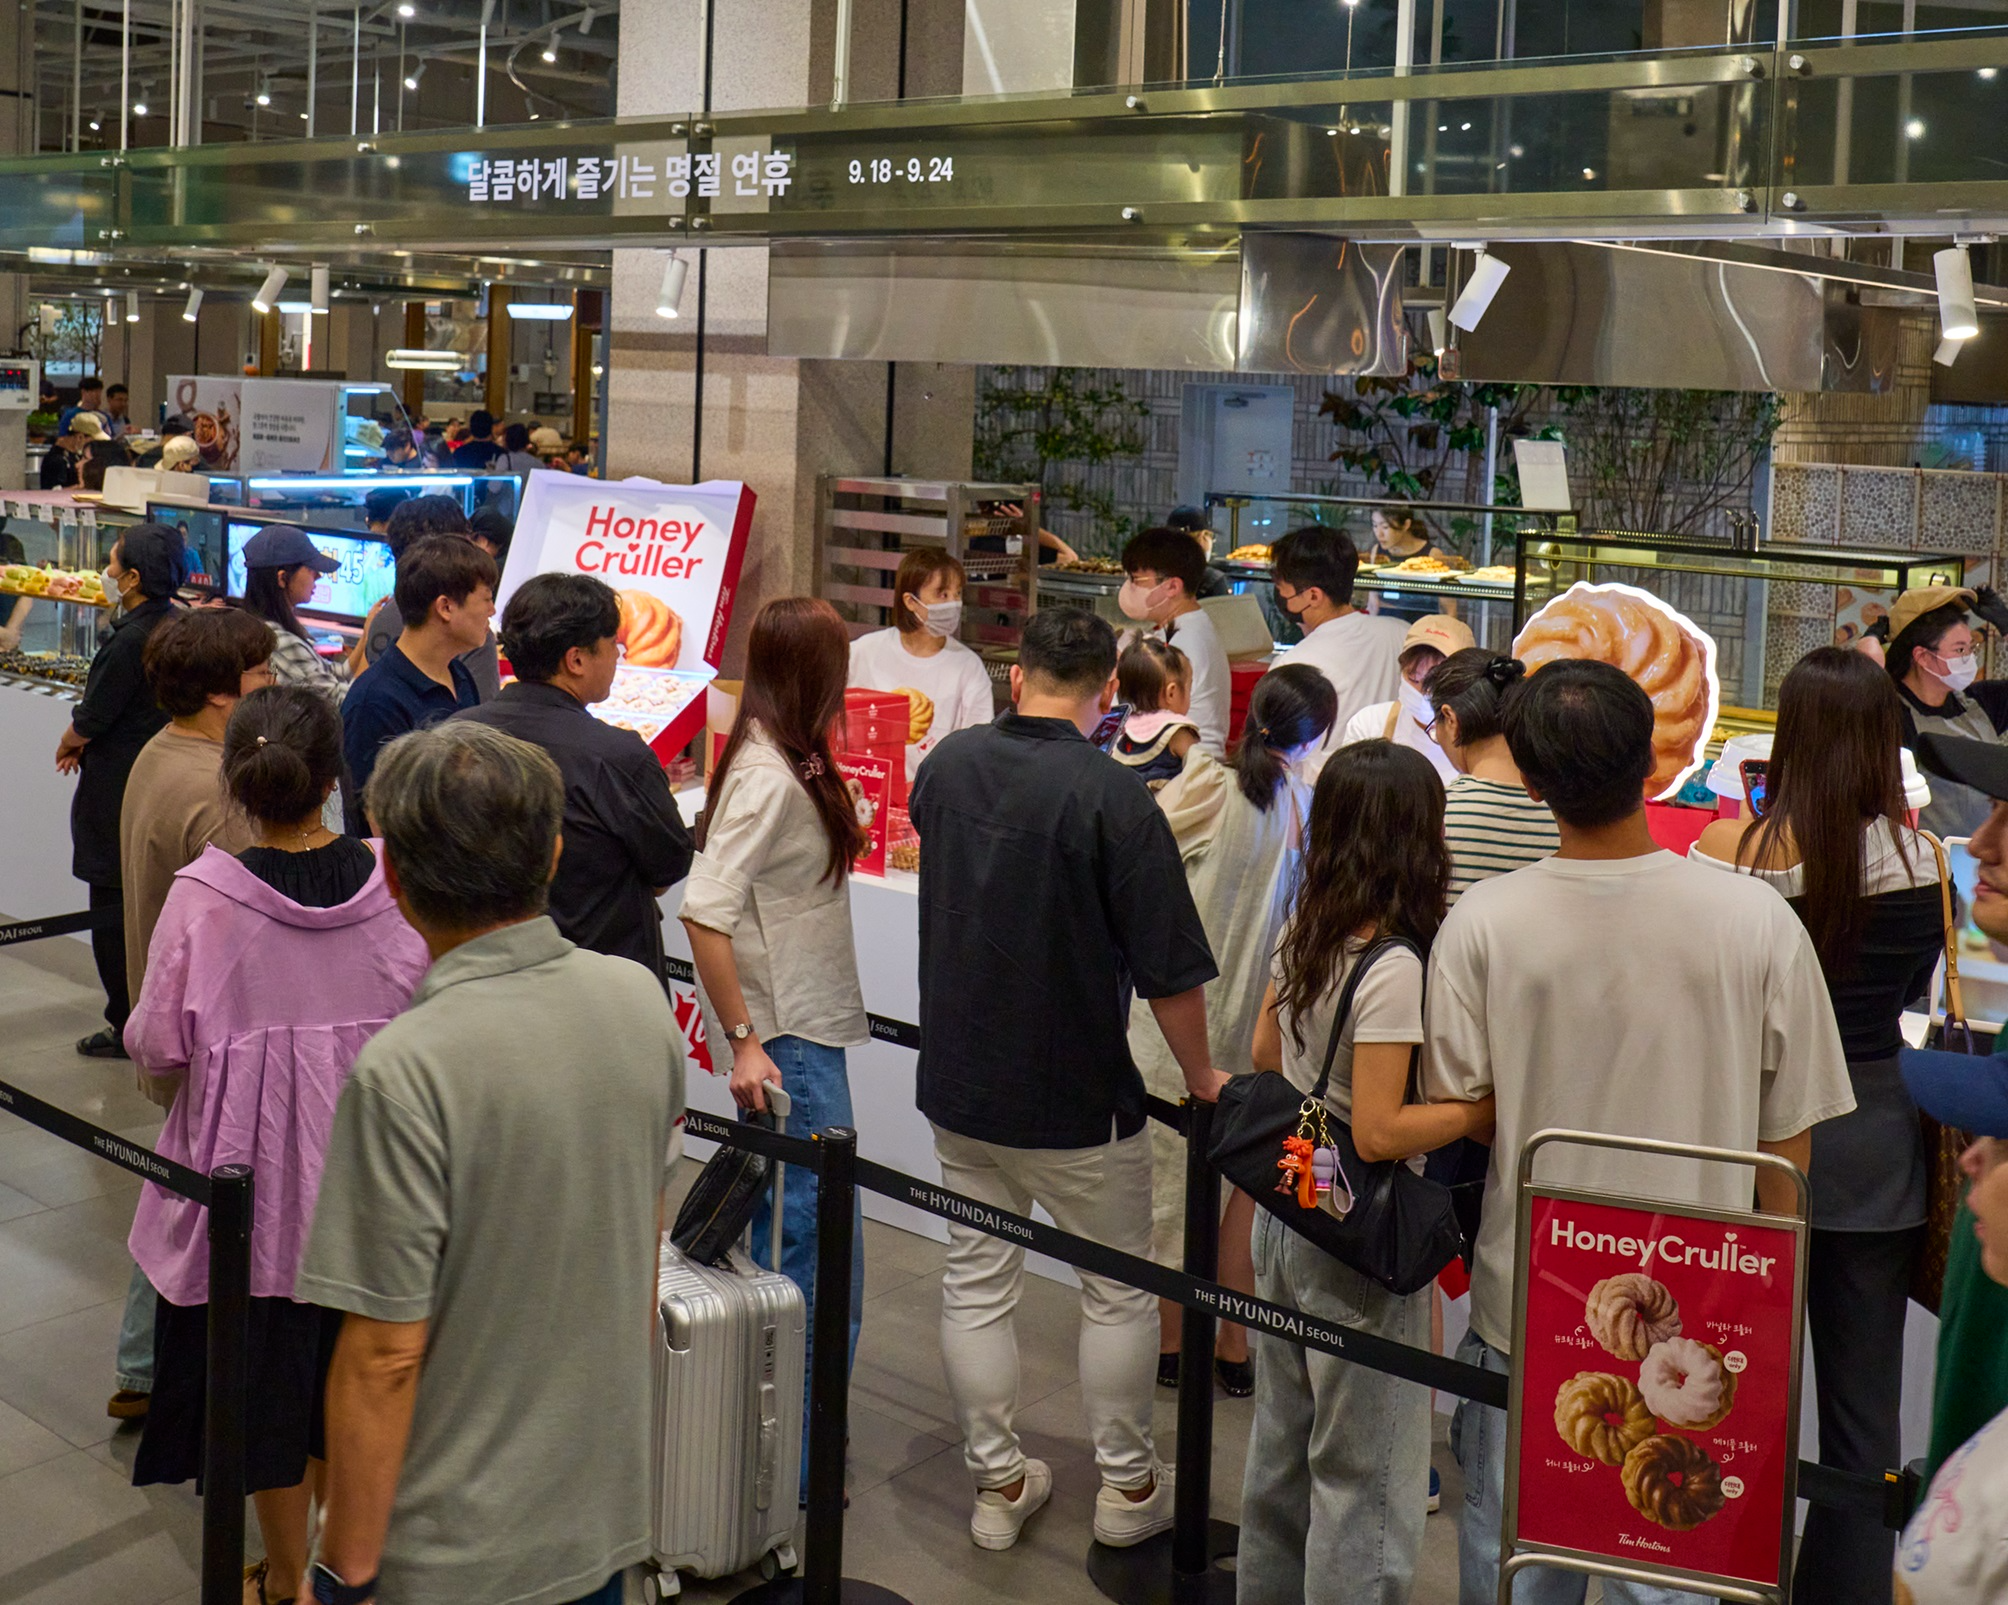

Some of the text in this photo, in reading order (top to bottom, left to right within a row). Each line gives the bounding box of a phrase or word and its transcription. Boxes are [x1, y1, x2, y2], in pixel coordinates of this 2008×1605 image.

[467, 150, 792, 202] 달콤하게 즐기는 명절 연휴
[585, 505, 705, 553] Honey
[874, 1022, 899, 1037] SEOUL
[703, 1124, 731, 1138] SEOUL
[93, 1135, 170, 1179] THE HYUNDAI SEOUL
[909, 1186, 1034, 1241] THE HYUNDAI SEOUL
[1194, 1288, 1345, 1348] THE HYUNDAI SEOUL
[1618, 1532, 1671, 1553] Tim Hortons
